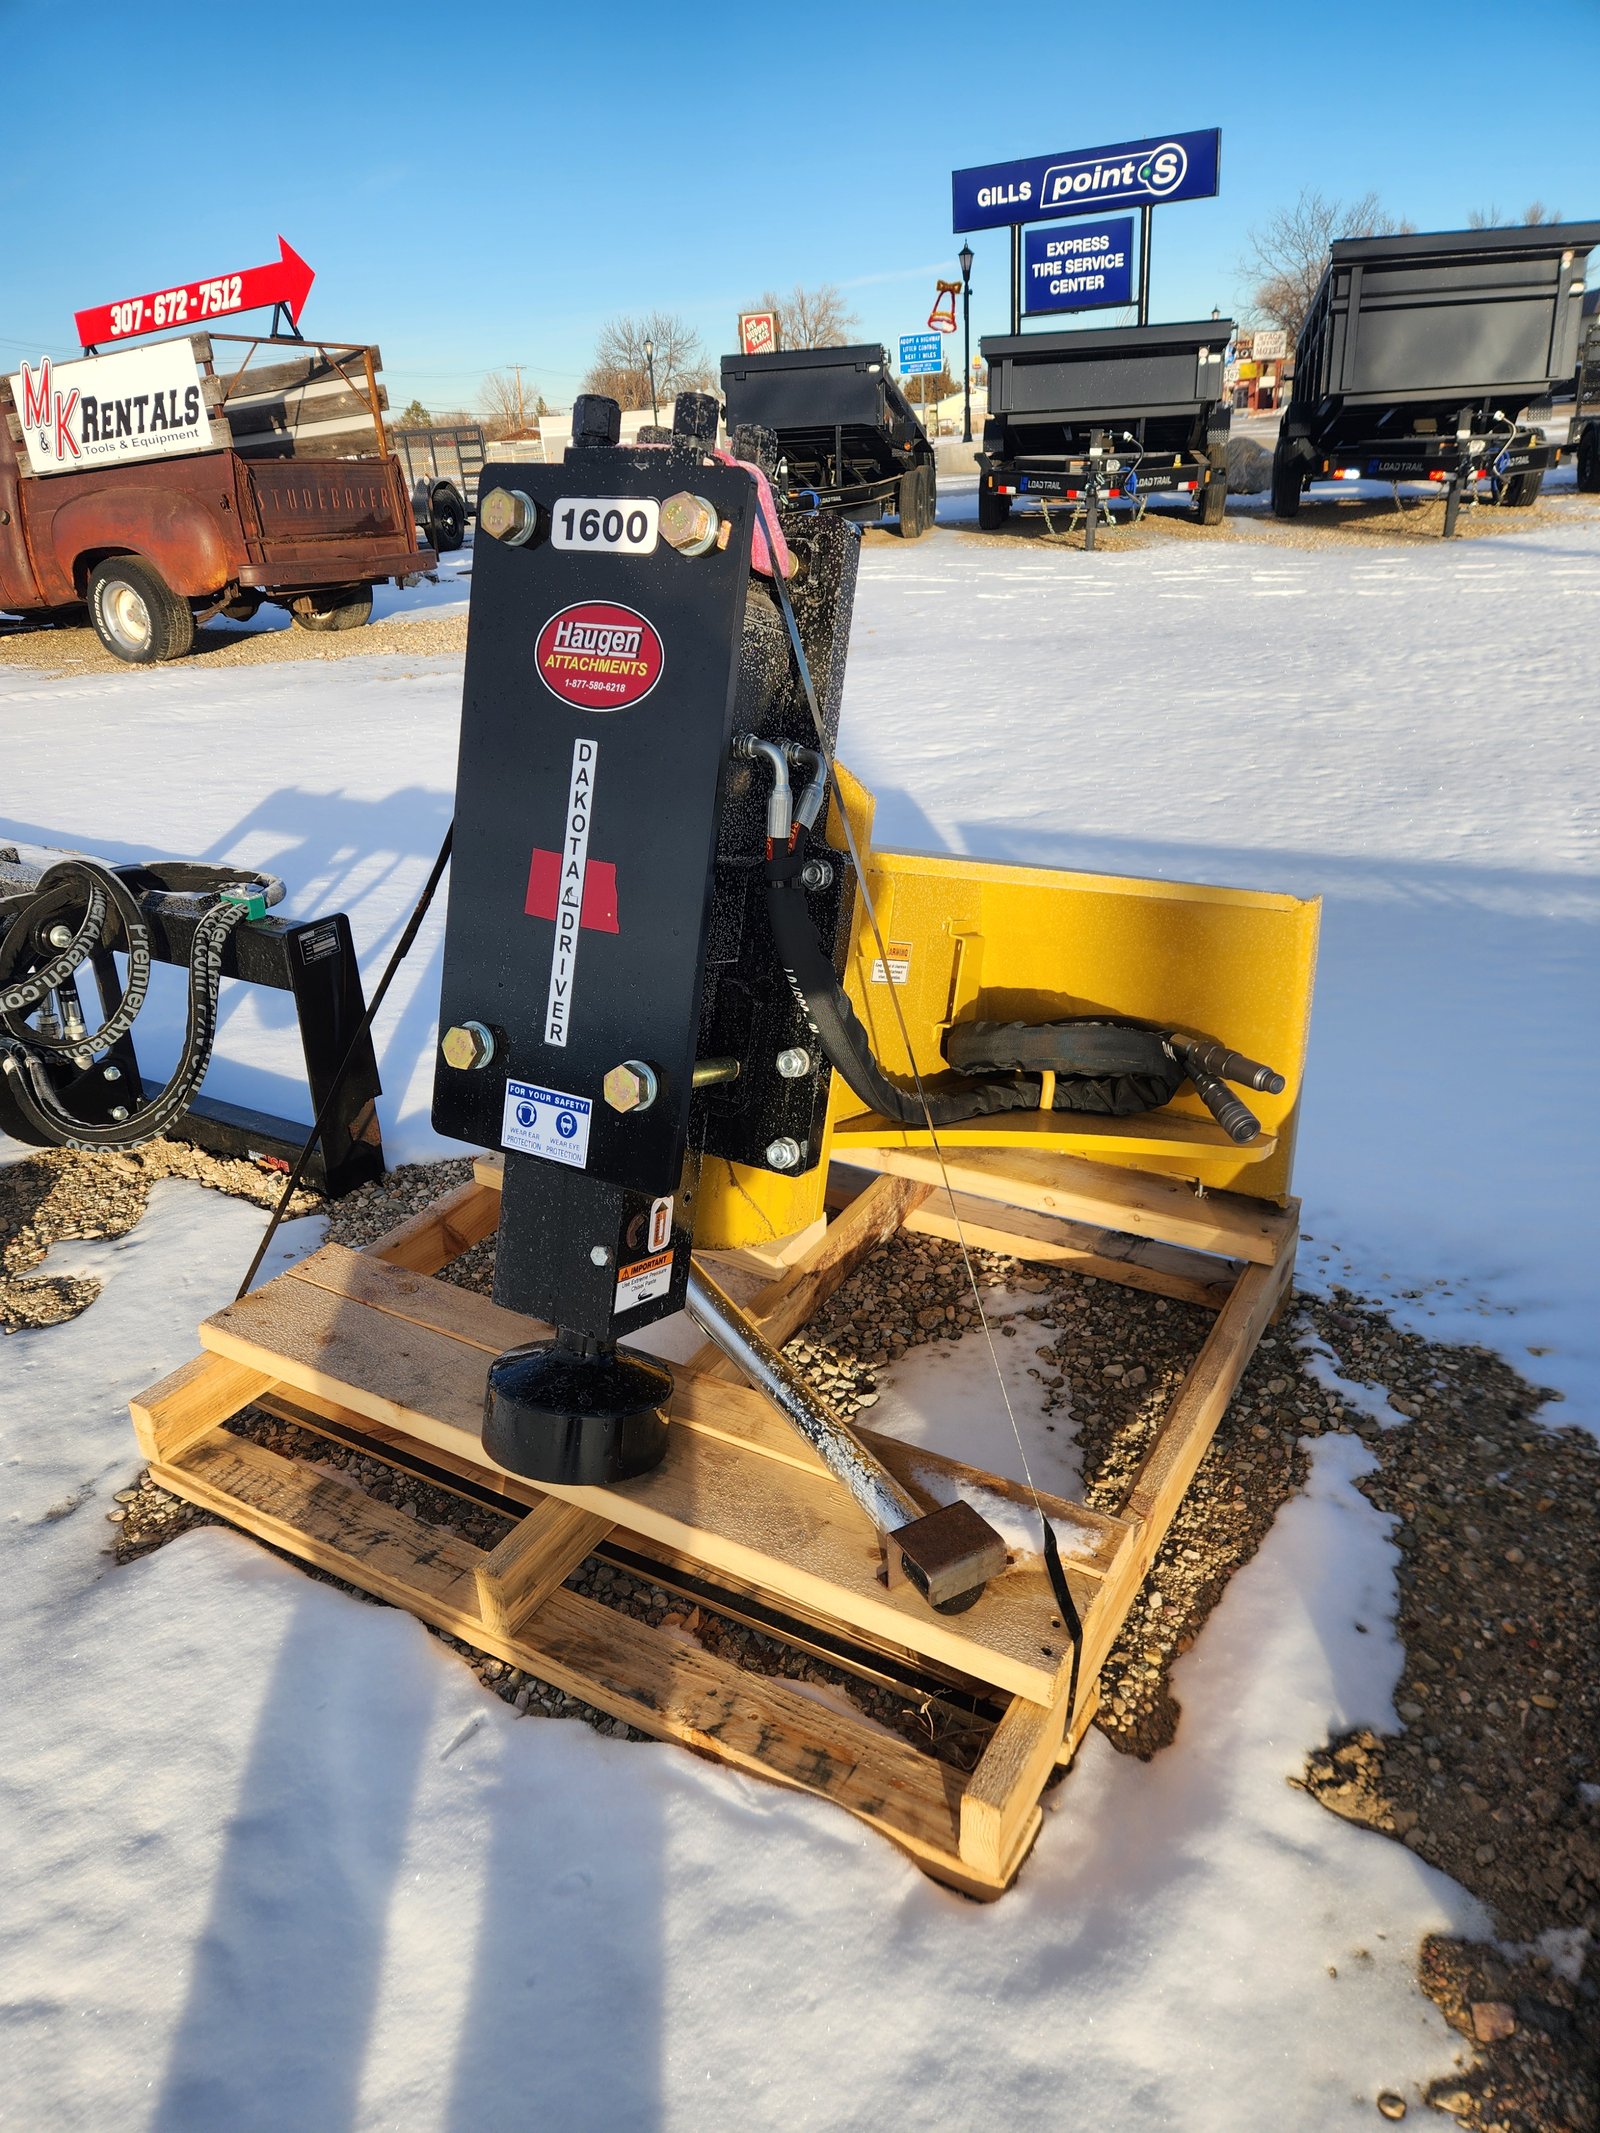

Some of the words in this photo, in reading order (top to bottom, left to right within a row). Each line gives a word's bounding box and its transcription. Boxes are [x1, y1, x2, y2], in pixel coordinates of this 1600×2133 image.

[977, 181, 1032, 207] GILLS
[1051, 162, 1136, 200] point
[1046, 235, 1110, 257] EXPRESS
[1032, 258, 1062, 278] TIRE
[1065, 252, 1125, 274] SERVICE
[1049, 274, 1105, 295] CENTER
[81, 385, 199, 443] RENTALS
[83, 443, 116, 455] Tools
[119, 440, 129, 449] &
[132, 428, 199, 447] Equipment
[256, 486, 391, 513] STUDEBAKER
[560, 508, 647, 543] 1600
[554, 620, 641, 658] Haugen
[545, 654, 649, 677] ATTACHMENTS
[564, 678, 626, 693] 1-877-580-6218
[564, 742, 593, 881] DAKOTA
[549, 911, 575, 1043] DRIVER
[510, 1085, 526, 1096] FOR
[528, 1090, 552, 1103] YOUR
[554, 1096, 589, 1112] SAFETY!
[506, 1134, 541, 1151] PROTECTION
[510, 1127, 528, 1137] WEAR
[527, 1131, 540, 1140] EAR
[550, 1137, 568, 1148] WEAR
[568, 1141, 580, 1151] EYE
[545, 1145, 582, 1162] PROTECTION
[630, 1255, 668, 1275] IMPORTANT
[621, 1279, 631, 1289] Use
